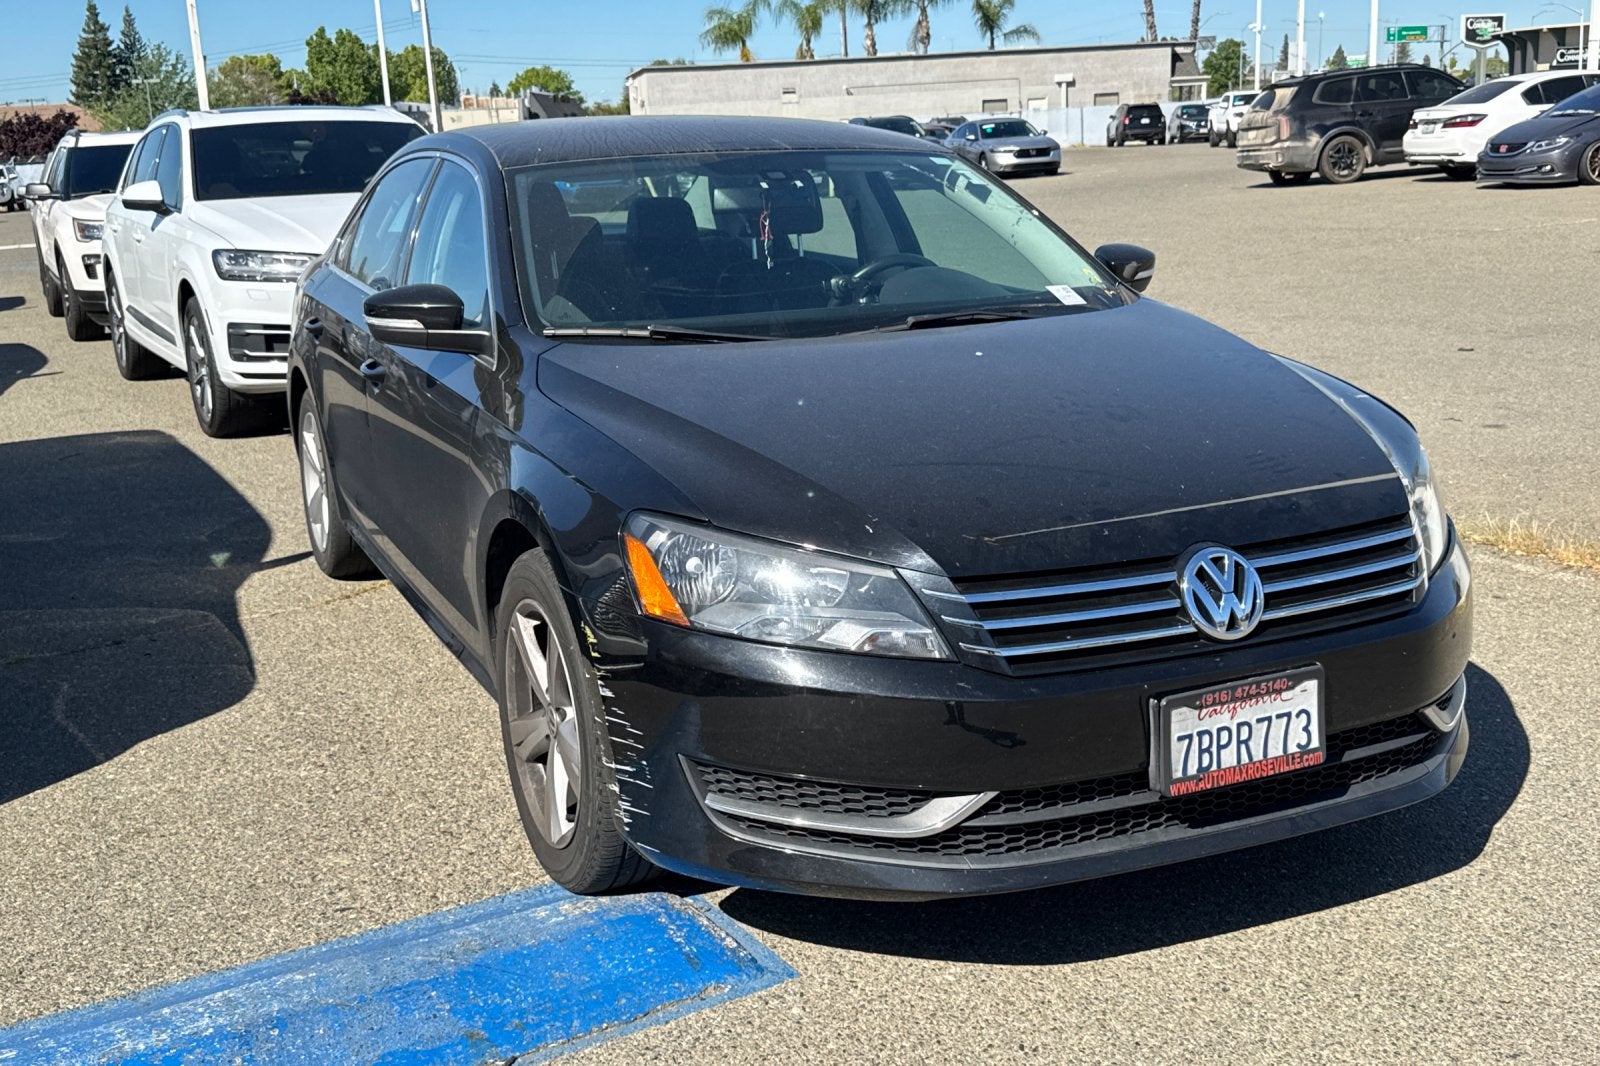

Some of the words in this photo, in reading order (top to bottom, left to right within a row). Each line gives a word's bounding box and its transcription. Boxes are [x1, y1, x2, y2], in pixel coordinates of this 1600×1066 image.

[1201, 689, 1232, 706] (916)
[1234, 678, 1288, 699] 474-5140
[1177, 709, 1312, 777] 7BPR773
